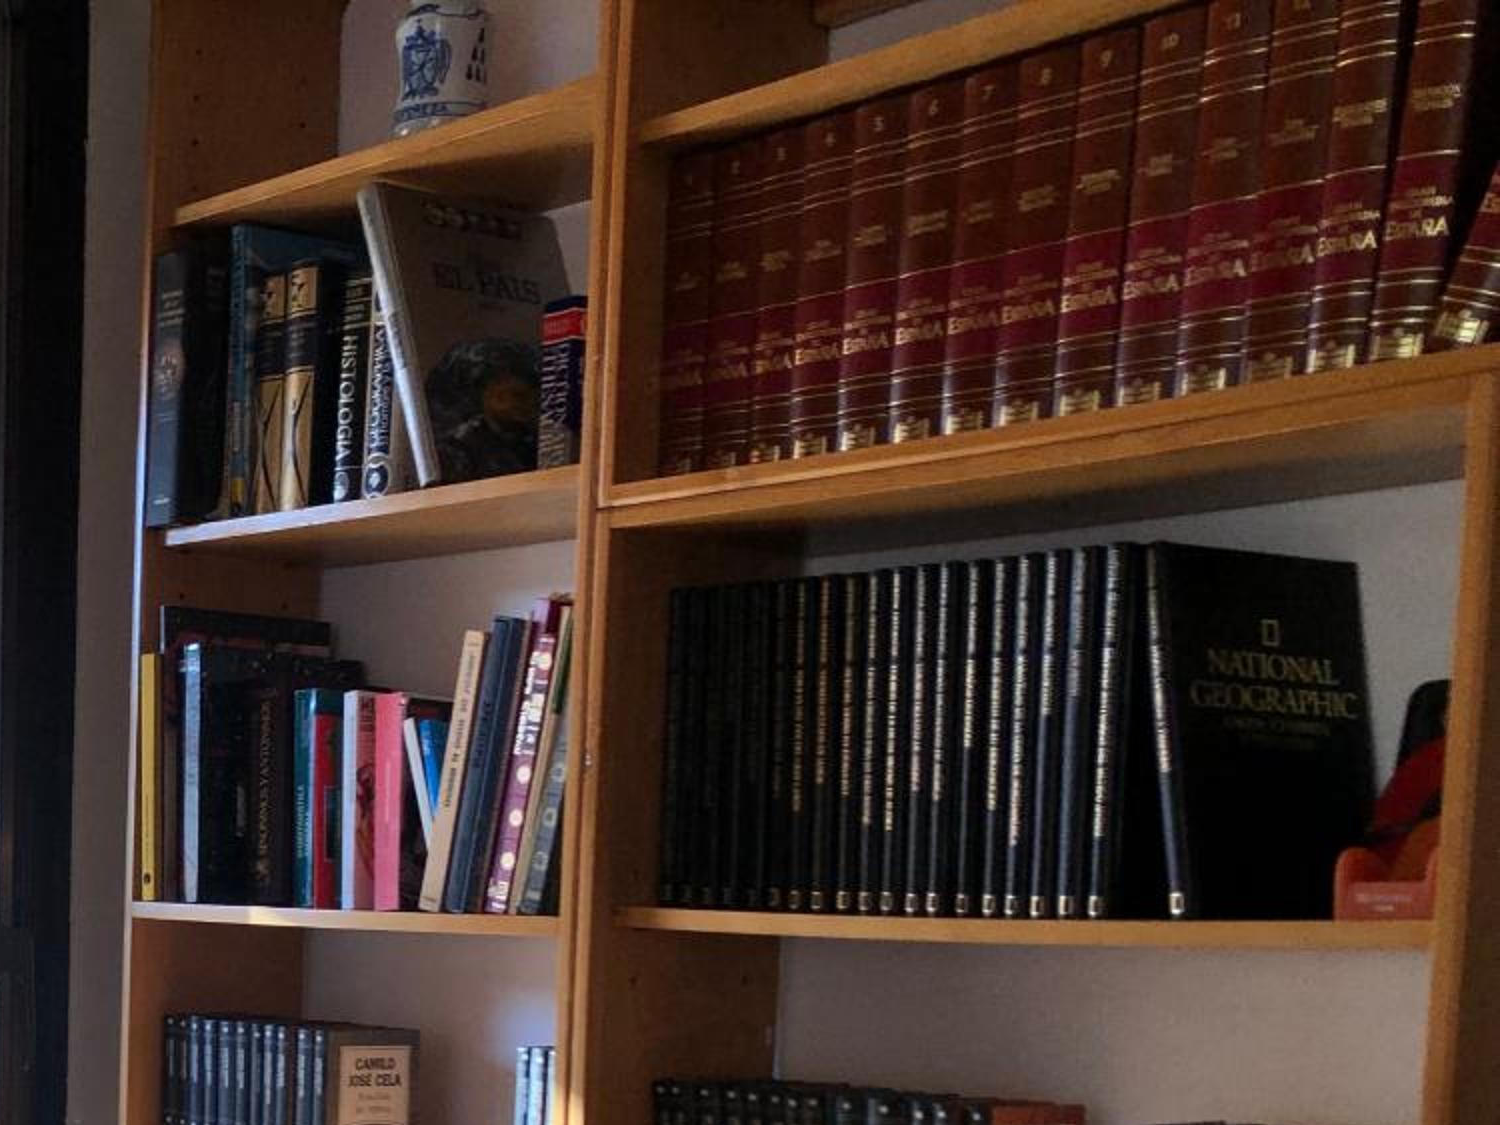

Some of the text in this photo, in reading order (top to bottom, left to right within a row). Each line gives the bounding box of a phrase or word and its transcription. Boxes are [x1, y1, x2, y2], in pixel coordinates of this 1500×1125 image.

[433, 261, 472, 292] EL
[1208, 649, 1340, 686] NATIONAL
[1190, 681, 1358, 719] GEOGRAPHIC
[355, 1057, 397, 1071] CAMILO
[376, 1073, 401, 1087] CELA
